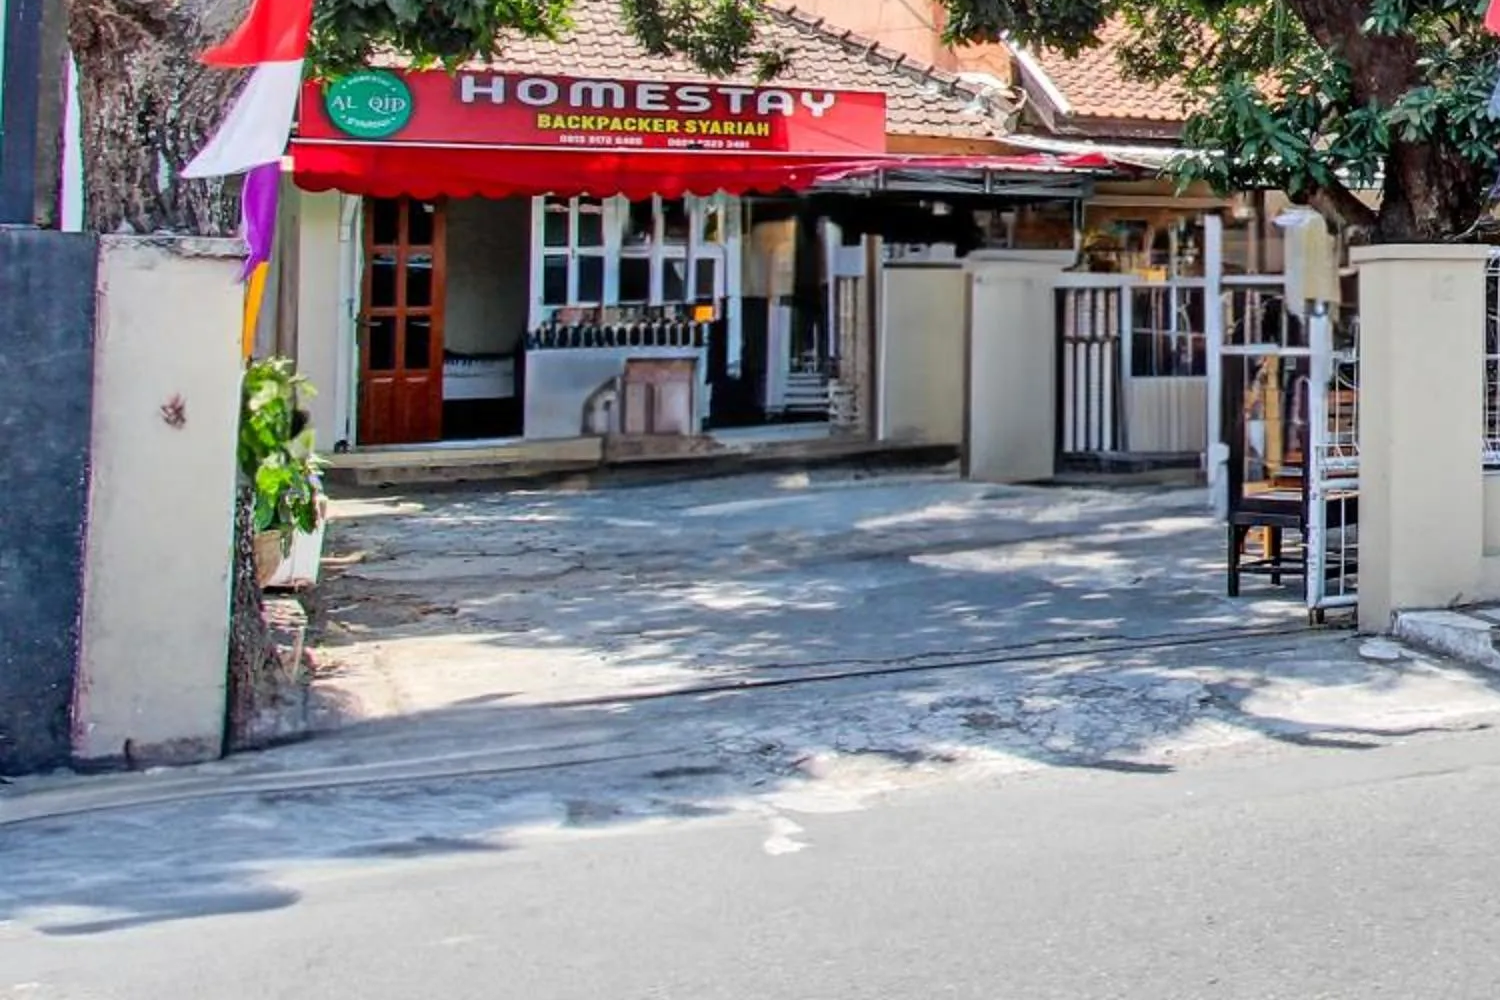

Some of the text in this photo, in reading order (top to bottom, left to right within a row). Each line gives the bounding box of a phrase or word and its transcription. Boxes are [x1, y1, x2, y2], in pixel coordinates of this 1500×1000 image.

[459, 75, 836, 117] HOMESTAY
[537, 112, 770, 136] BACKPACKER SYARIAH
